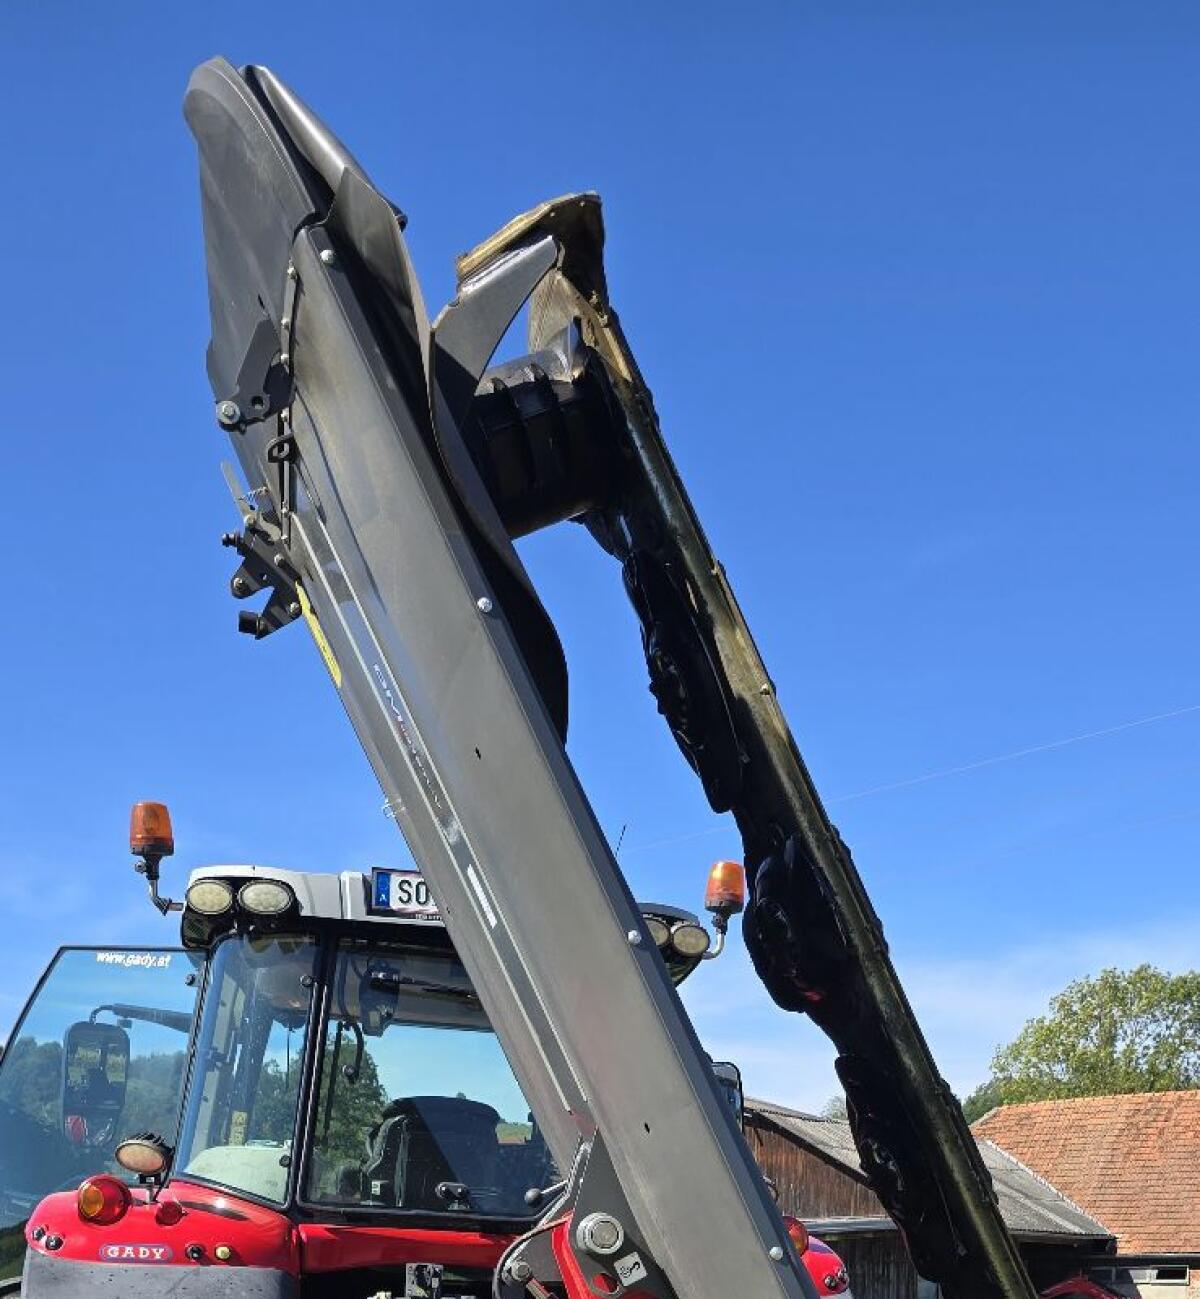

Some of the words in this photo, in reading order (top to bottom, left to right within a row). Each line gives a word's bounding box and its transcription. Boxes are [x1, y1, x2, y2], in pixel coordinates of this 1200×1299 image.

[398, 879, 428, 905] SO
[97, 951, 171, 968] www.gady.at
[107, 1246, 165, 1259] GADY
